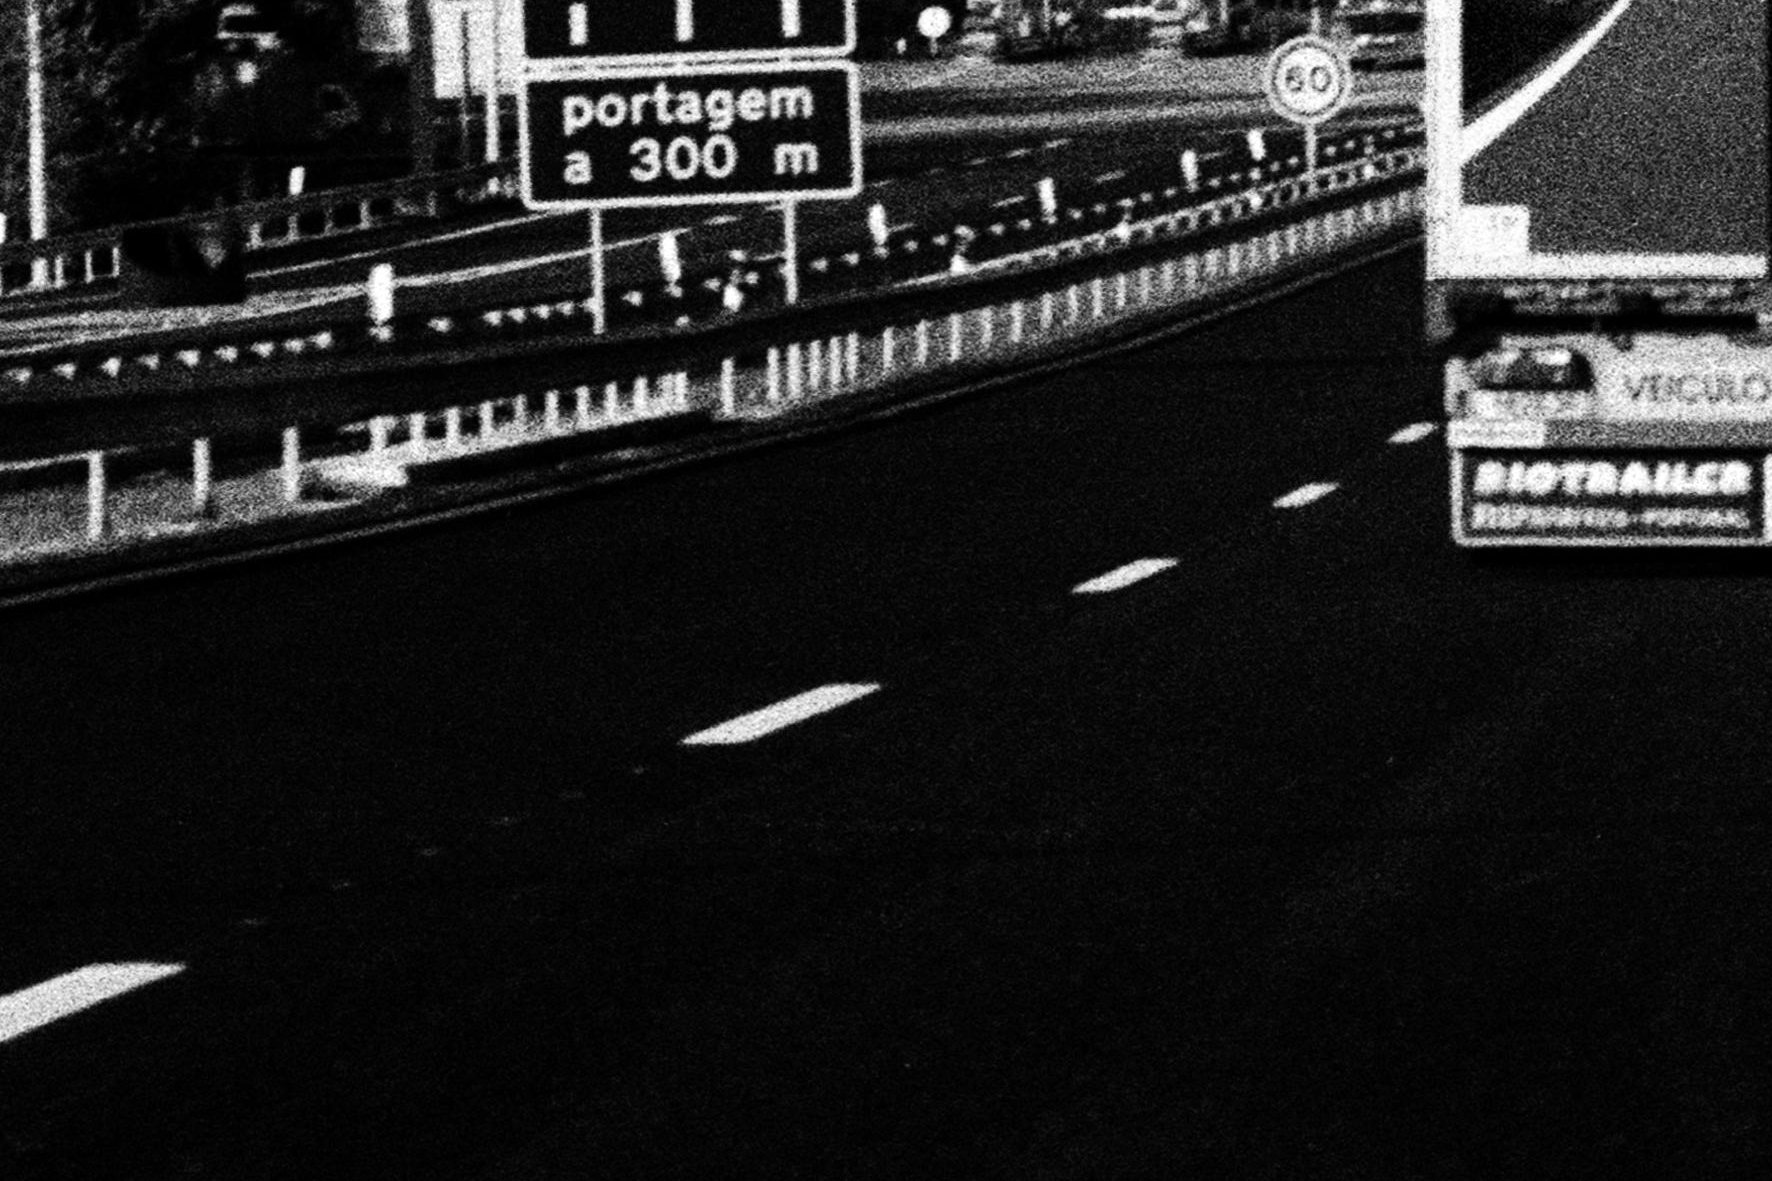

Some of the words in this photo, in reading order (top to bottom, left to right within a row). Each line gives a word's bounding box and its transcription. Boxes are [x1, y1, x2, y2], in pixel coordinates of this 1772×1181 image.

[1285, 65, 1332, 92] 60
[562, 82, 815, 135] portagem
[563, 150, 593, 185] a
[629, 133, 738, 182] 300
[773, 141, 819, 175] m
